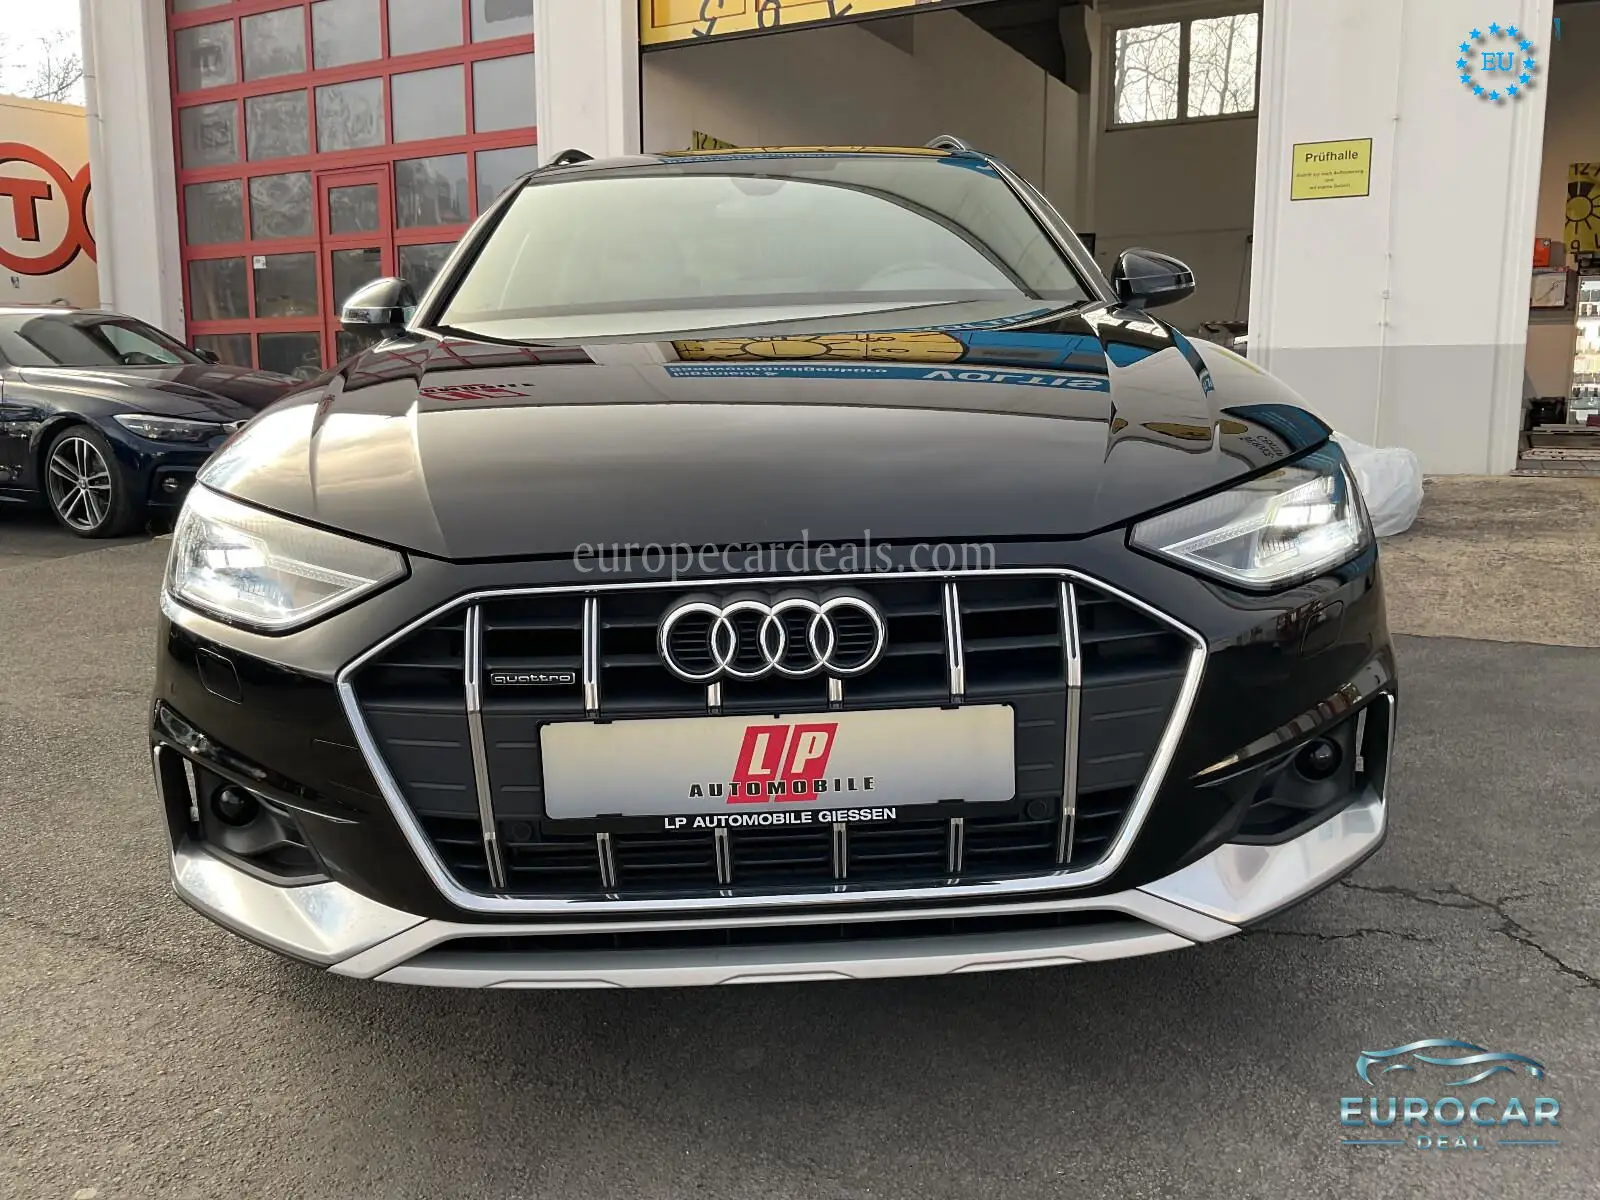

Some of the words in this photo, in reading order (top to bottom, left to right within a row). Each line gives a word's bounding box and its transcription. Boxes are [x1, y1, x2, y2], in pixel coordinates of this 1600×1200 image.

[1305, 149, 1359, 163] Prüfhalle
[494, 674, 571, 684] quattro
[748, 731, 829, 775] LP
[689, 776, 875, 798] AUTOMOBILE
[664, 817, 687, 829] LP
[693, 811, 812, 828] AUTOMOBILE
[818, 807, 896, 823] GIESSEN
